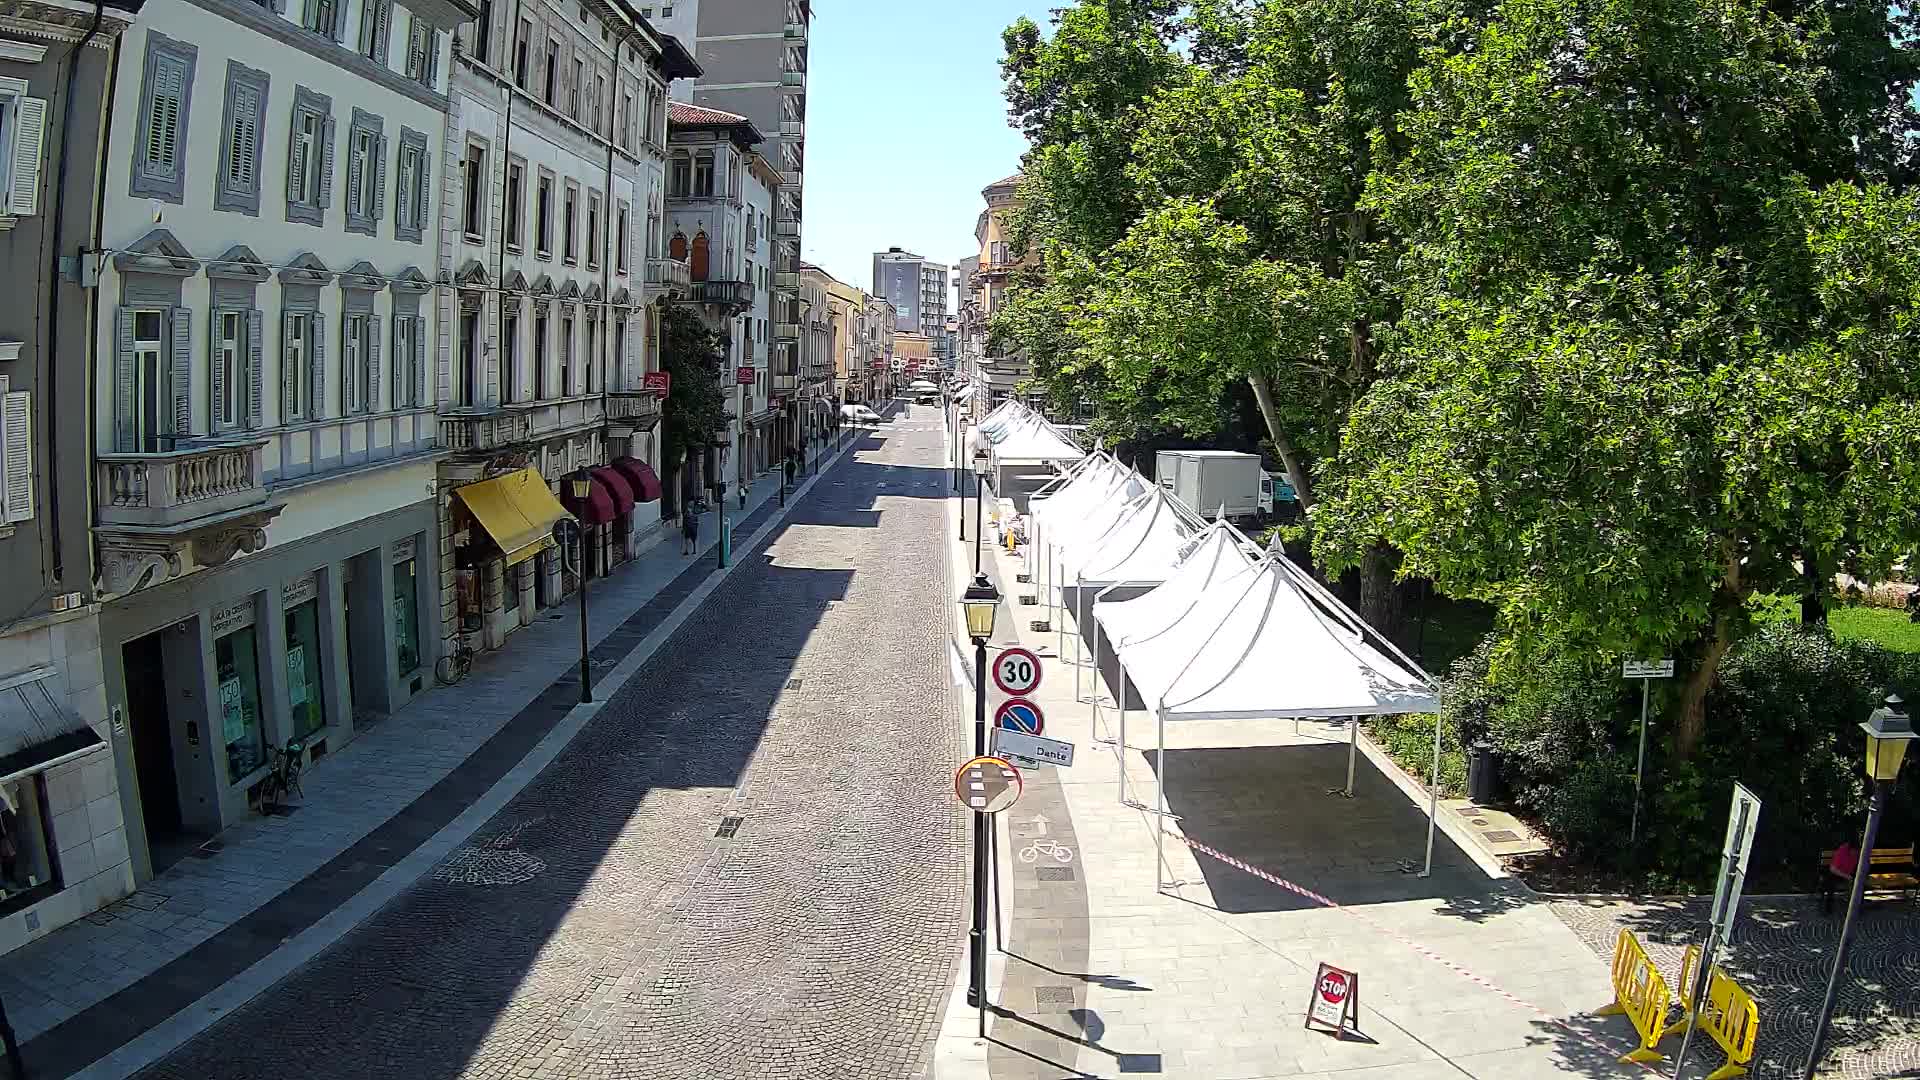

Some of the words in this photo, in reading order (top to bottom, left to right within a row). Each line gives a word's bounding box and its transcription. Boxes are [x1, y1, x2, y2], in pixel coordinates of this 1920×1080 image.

[1004, 661, 1031, 683] 30
[1036, 747, 1067, 762] Dante
[1320, 980, 1346, 997] STOP
